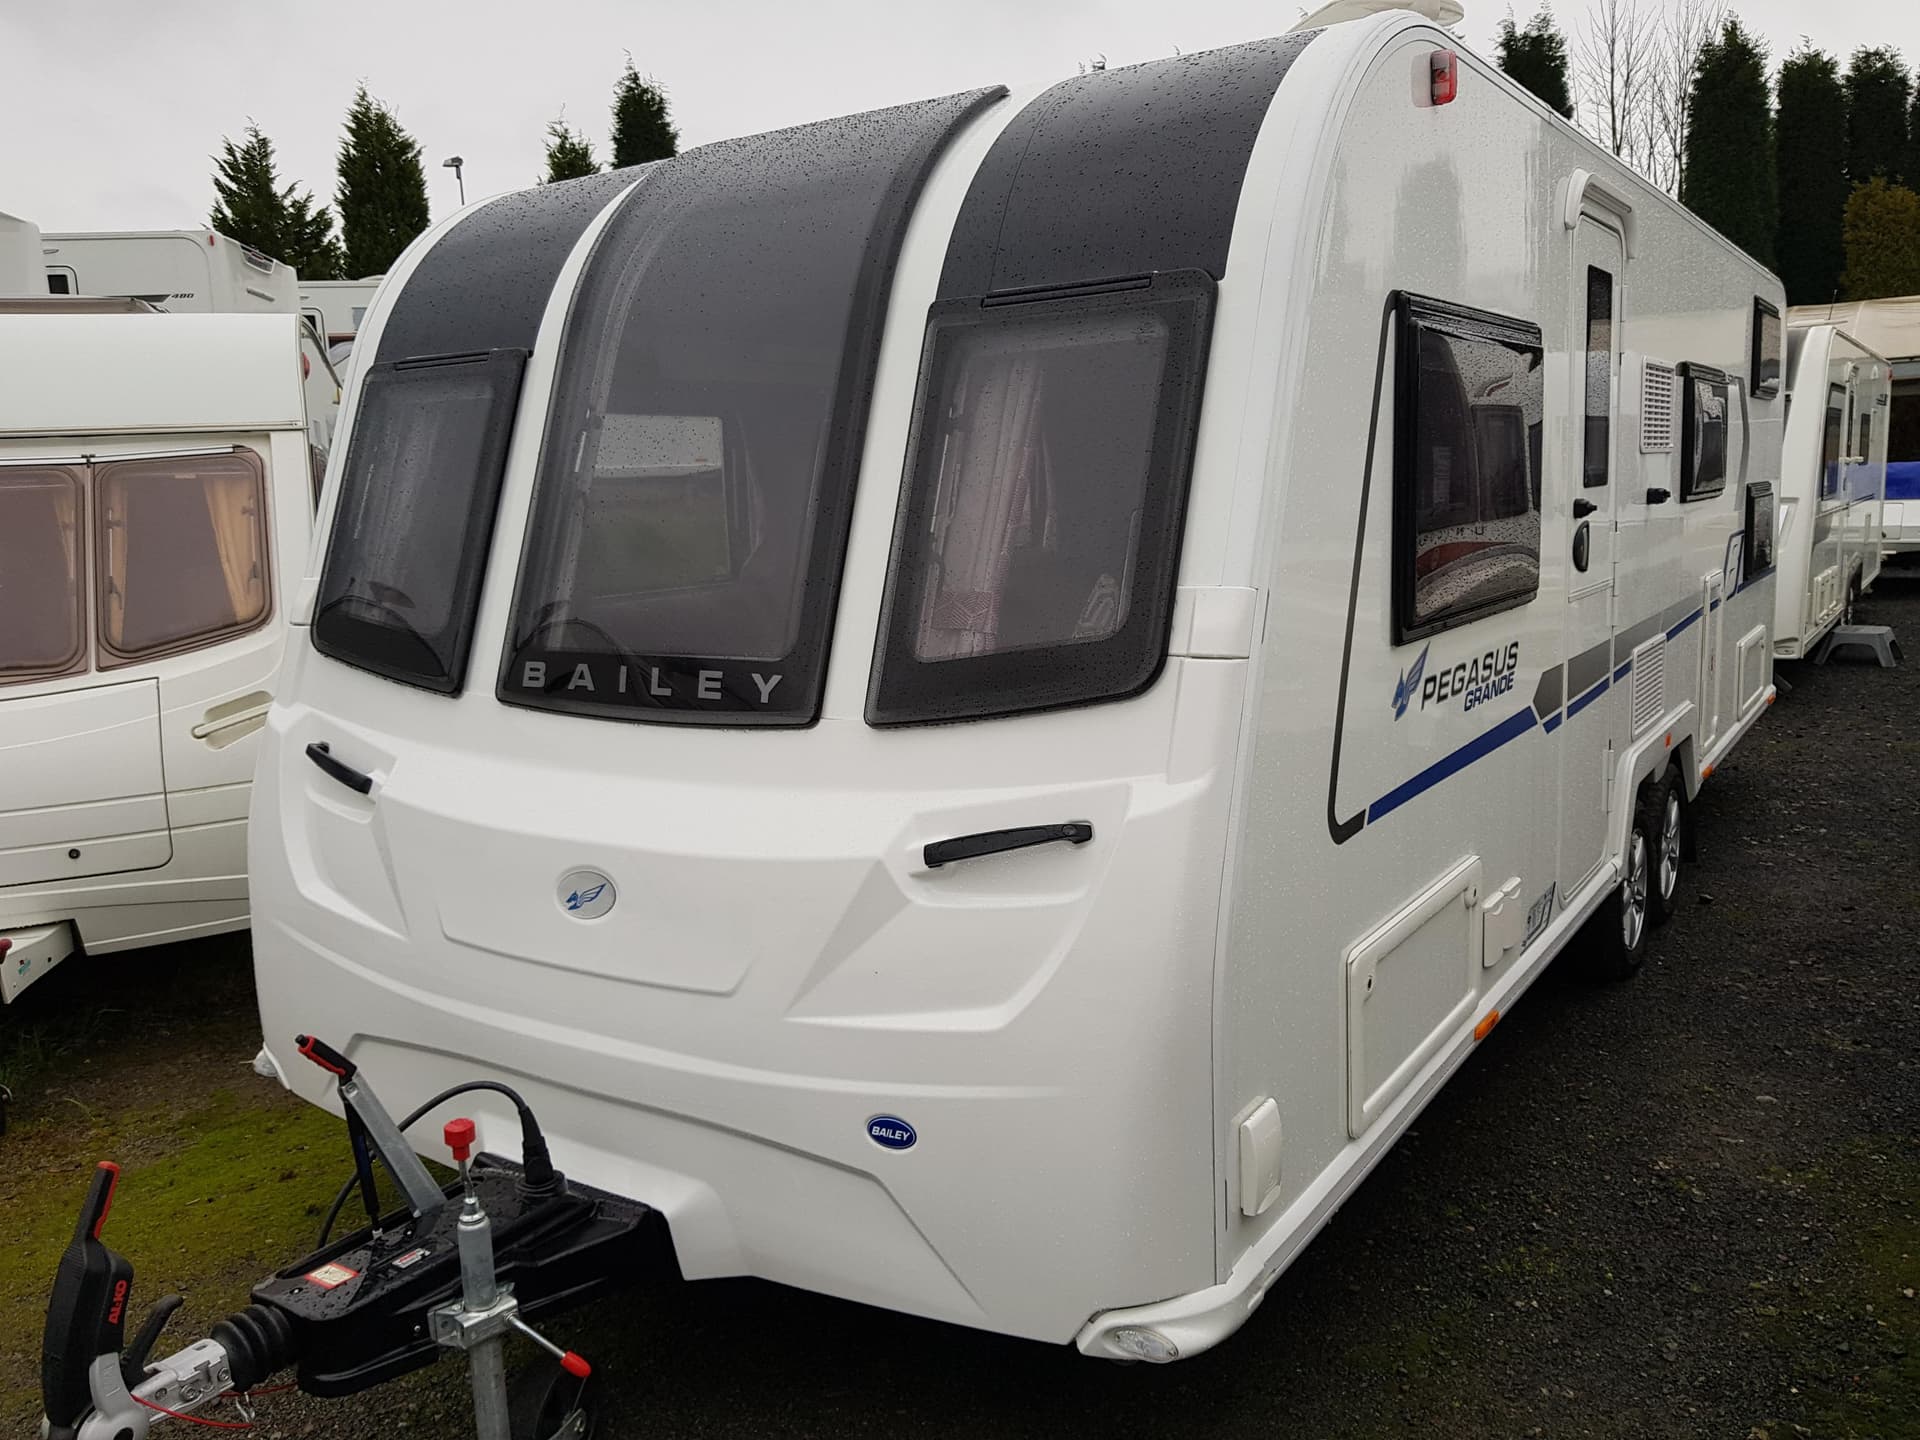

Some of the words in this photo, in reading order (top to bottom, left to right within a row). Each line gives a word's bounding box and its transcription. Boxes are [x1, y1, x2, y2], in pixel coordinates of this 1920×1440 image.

[522, 661, 783, 704] BAILEY
[1421, 641, 1519, 712] PEGASUS
[1464, 671, 1515, 712] GRANDE
[871, 1125, 911, 1142] BAILEY
